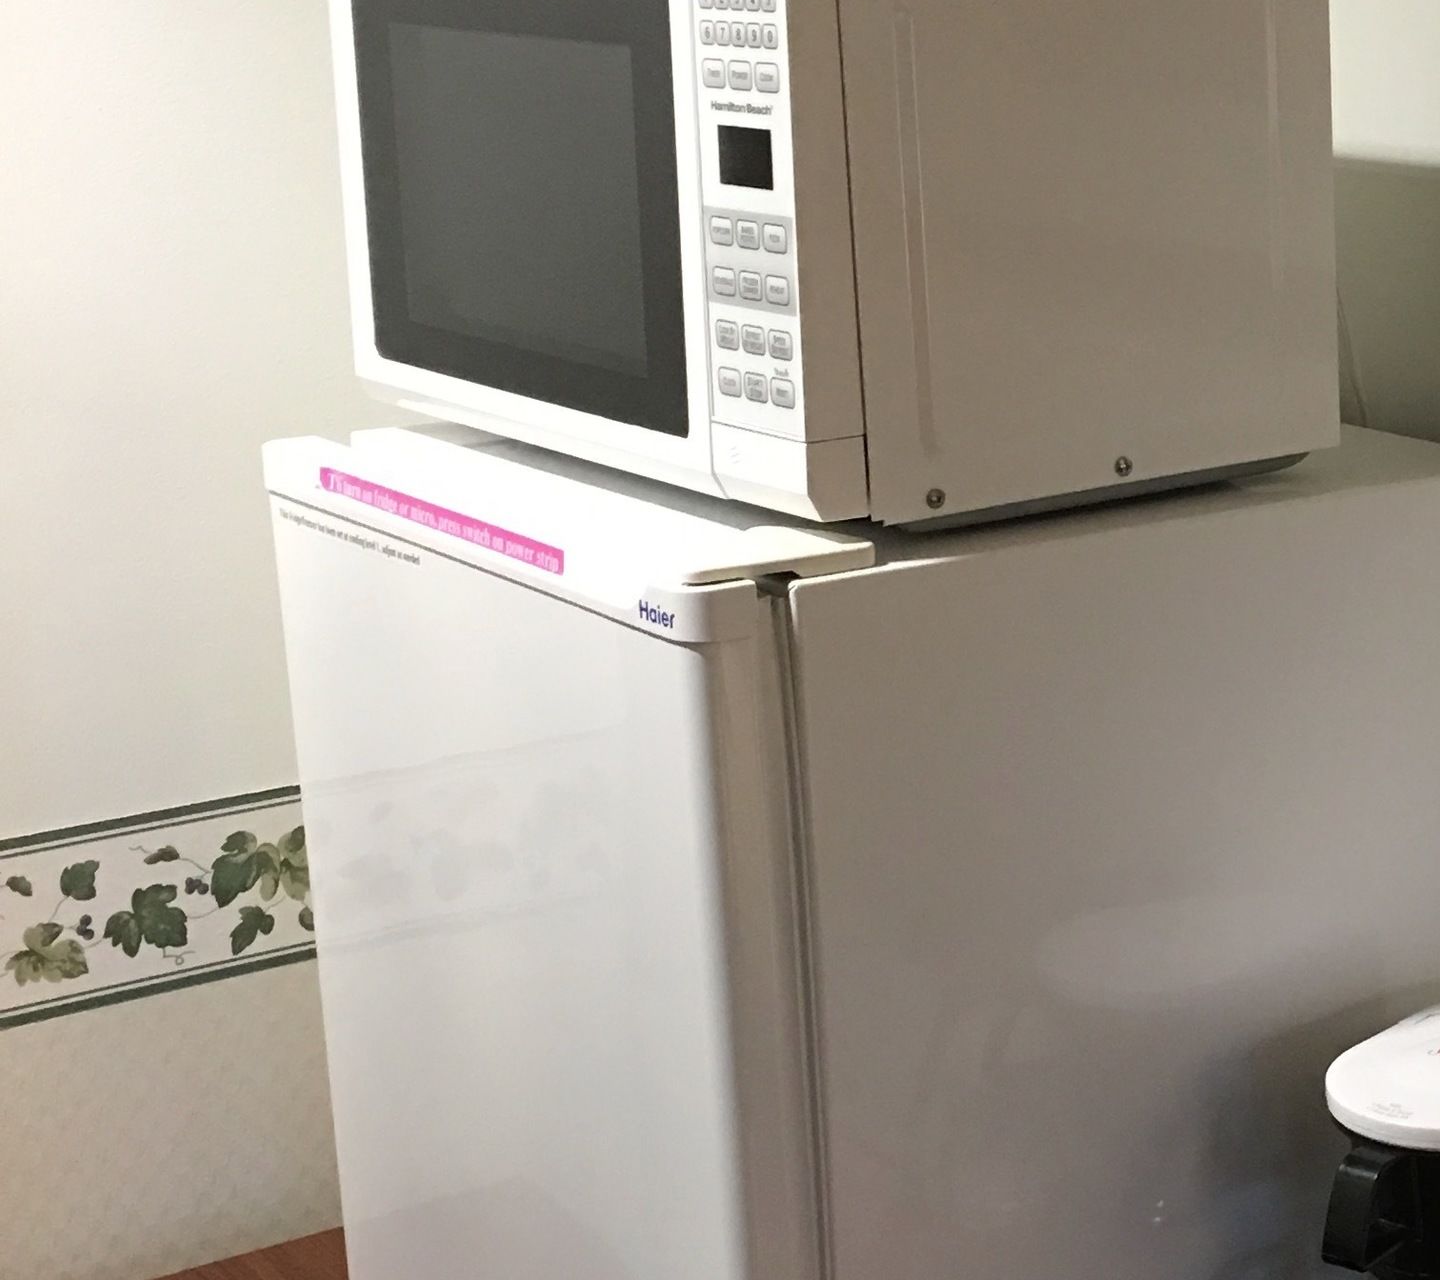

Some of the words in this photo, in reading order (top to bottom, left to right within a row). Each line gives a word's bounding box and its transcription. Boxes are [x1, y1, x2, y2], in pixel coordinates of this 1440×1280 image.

[711, 100, 746, 113] Hamilton
[746, 103, 772, 115] Beach
[438, 516, 460, 538] press
[462, 523, 490, 546] switch
[492, 535, 504, 551] on
[505, 539, 534, 562] power
[536, 551, 559, 574] strip
[638, 599, 675, 629] Haier
